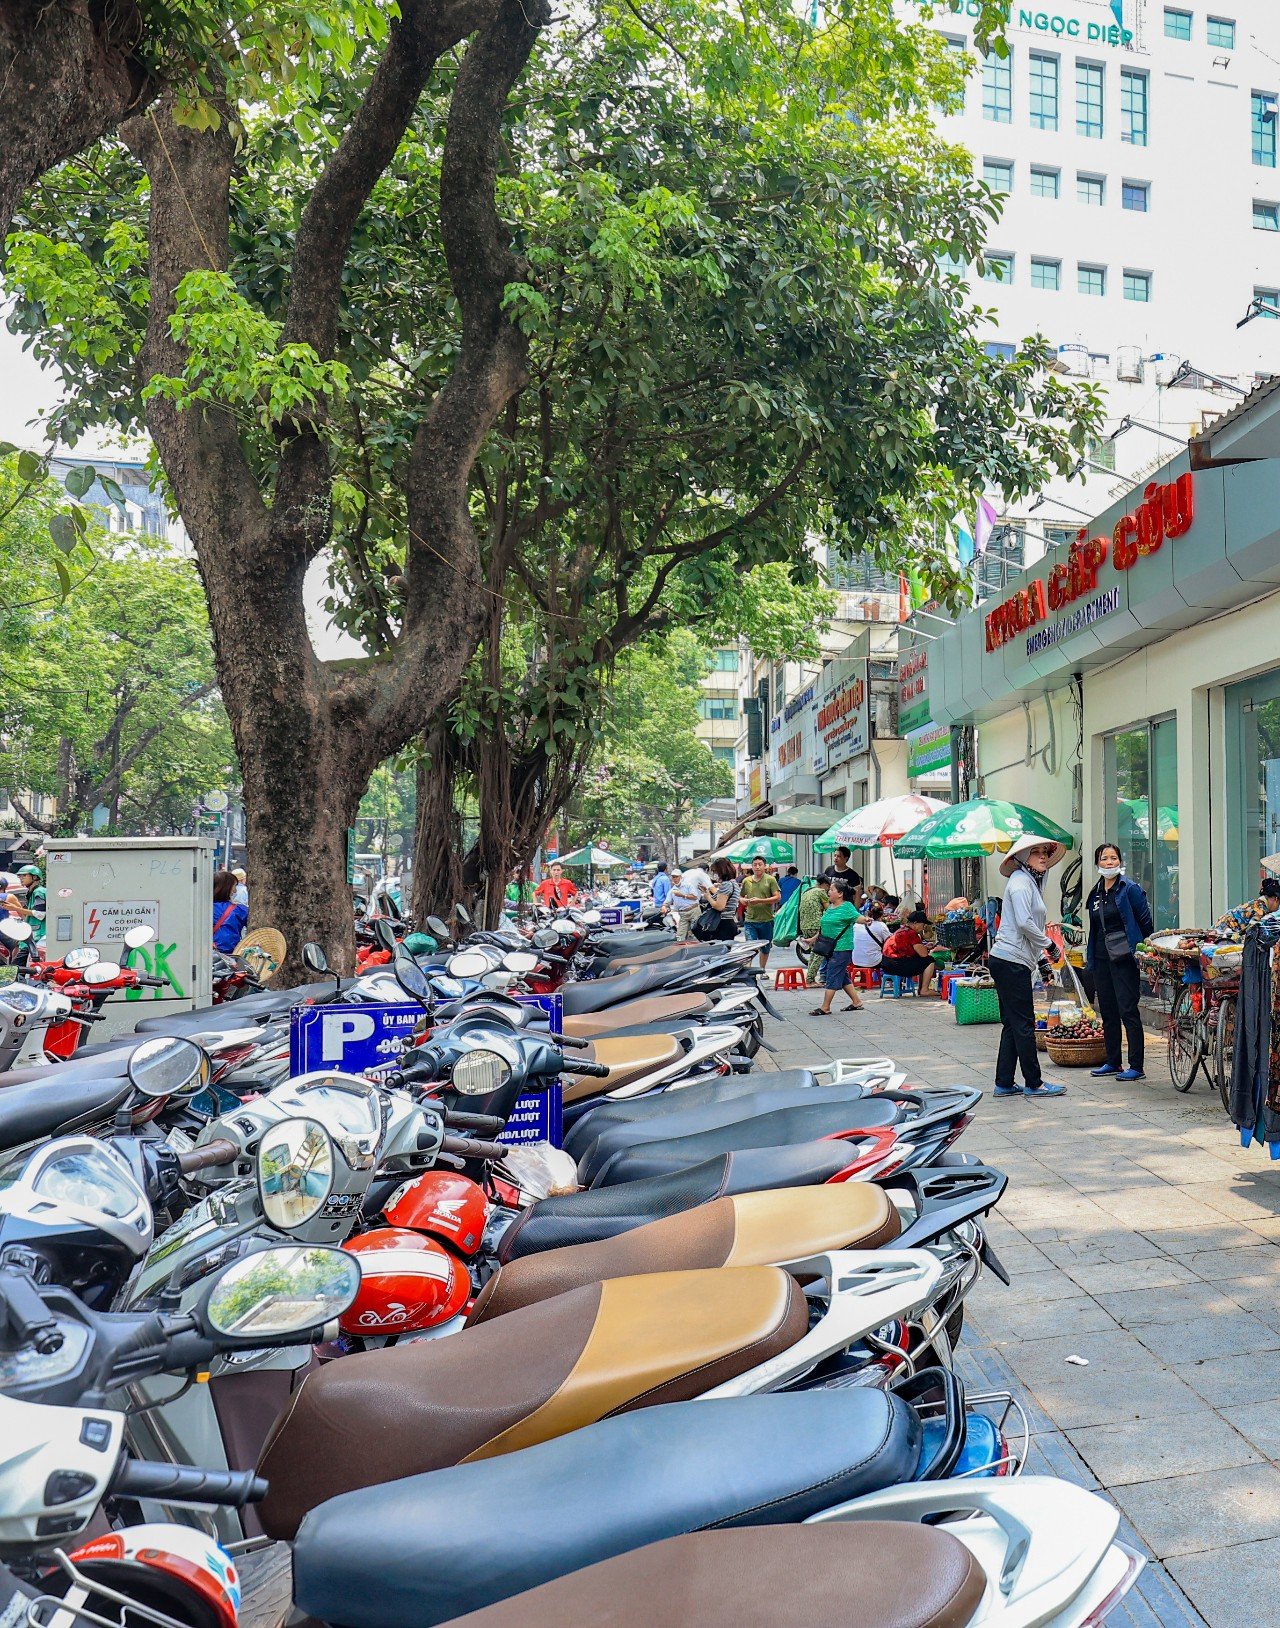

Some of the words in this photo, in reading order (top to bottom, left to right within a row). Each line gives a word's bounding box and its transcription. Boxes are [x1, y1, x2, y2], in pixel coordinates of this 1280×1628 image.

[1019, 9, 1080, 38] NGỌC
[1048, 528, 1110, 611] CẤP
[1113, 472, 1194, 570] CỨU
[102, 907, 119, 915] CẤM
[121, 908, 133, 916] LẠI
[134, 906, 151, 915] GẦN
[107, 931, 125, 939] CHẾT
[382, 1013, 395, 1025] ỦY
[396, 1014, 415, 1025] BAN
[322, 1013, 375, 1061] P
[432, 1208, 462, 1224] HONDA
